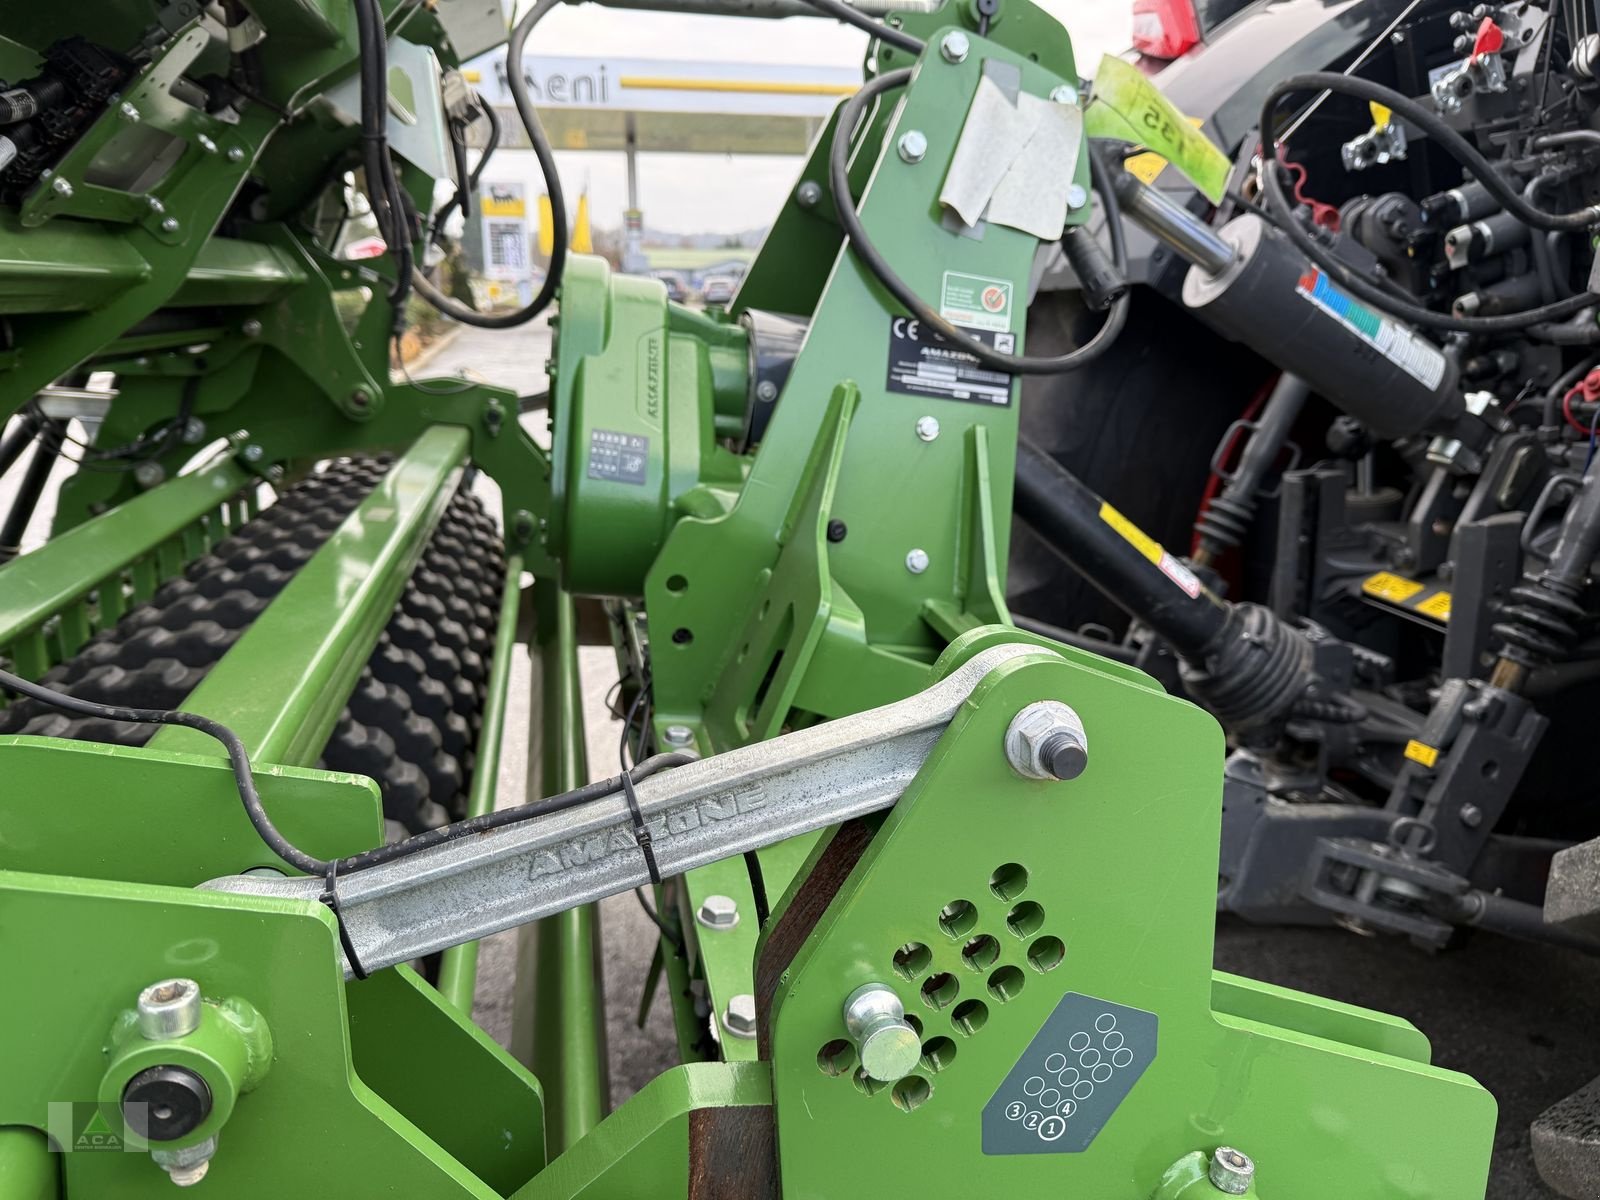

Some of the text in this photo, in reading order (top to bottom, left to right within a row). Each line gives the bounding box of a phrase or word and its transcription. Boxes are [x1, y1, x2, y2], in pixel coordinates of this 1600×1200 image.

[546, 63, 609, 103] eni
[893, 317, 919, 341] CE
[1010, 1104, 1020, 1118] 3
[1061, 1102, 1071, 1115] 4
[1028, 1114, 1038, 1127] 2
[1047, 1122, 1055, 1135] 1
